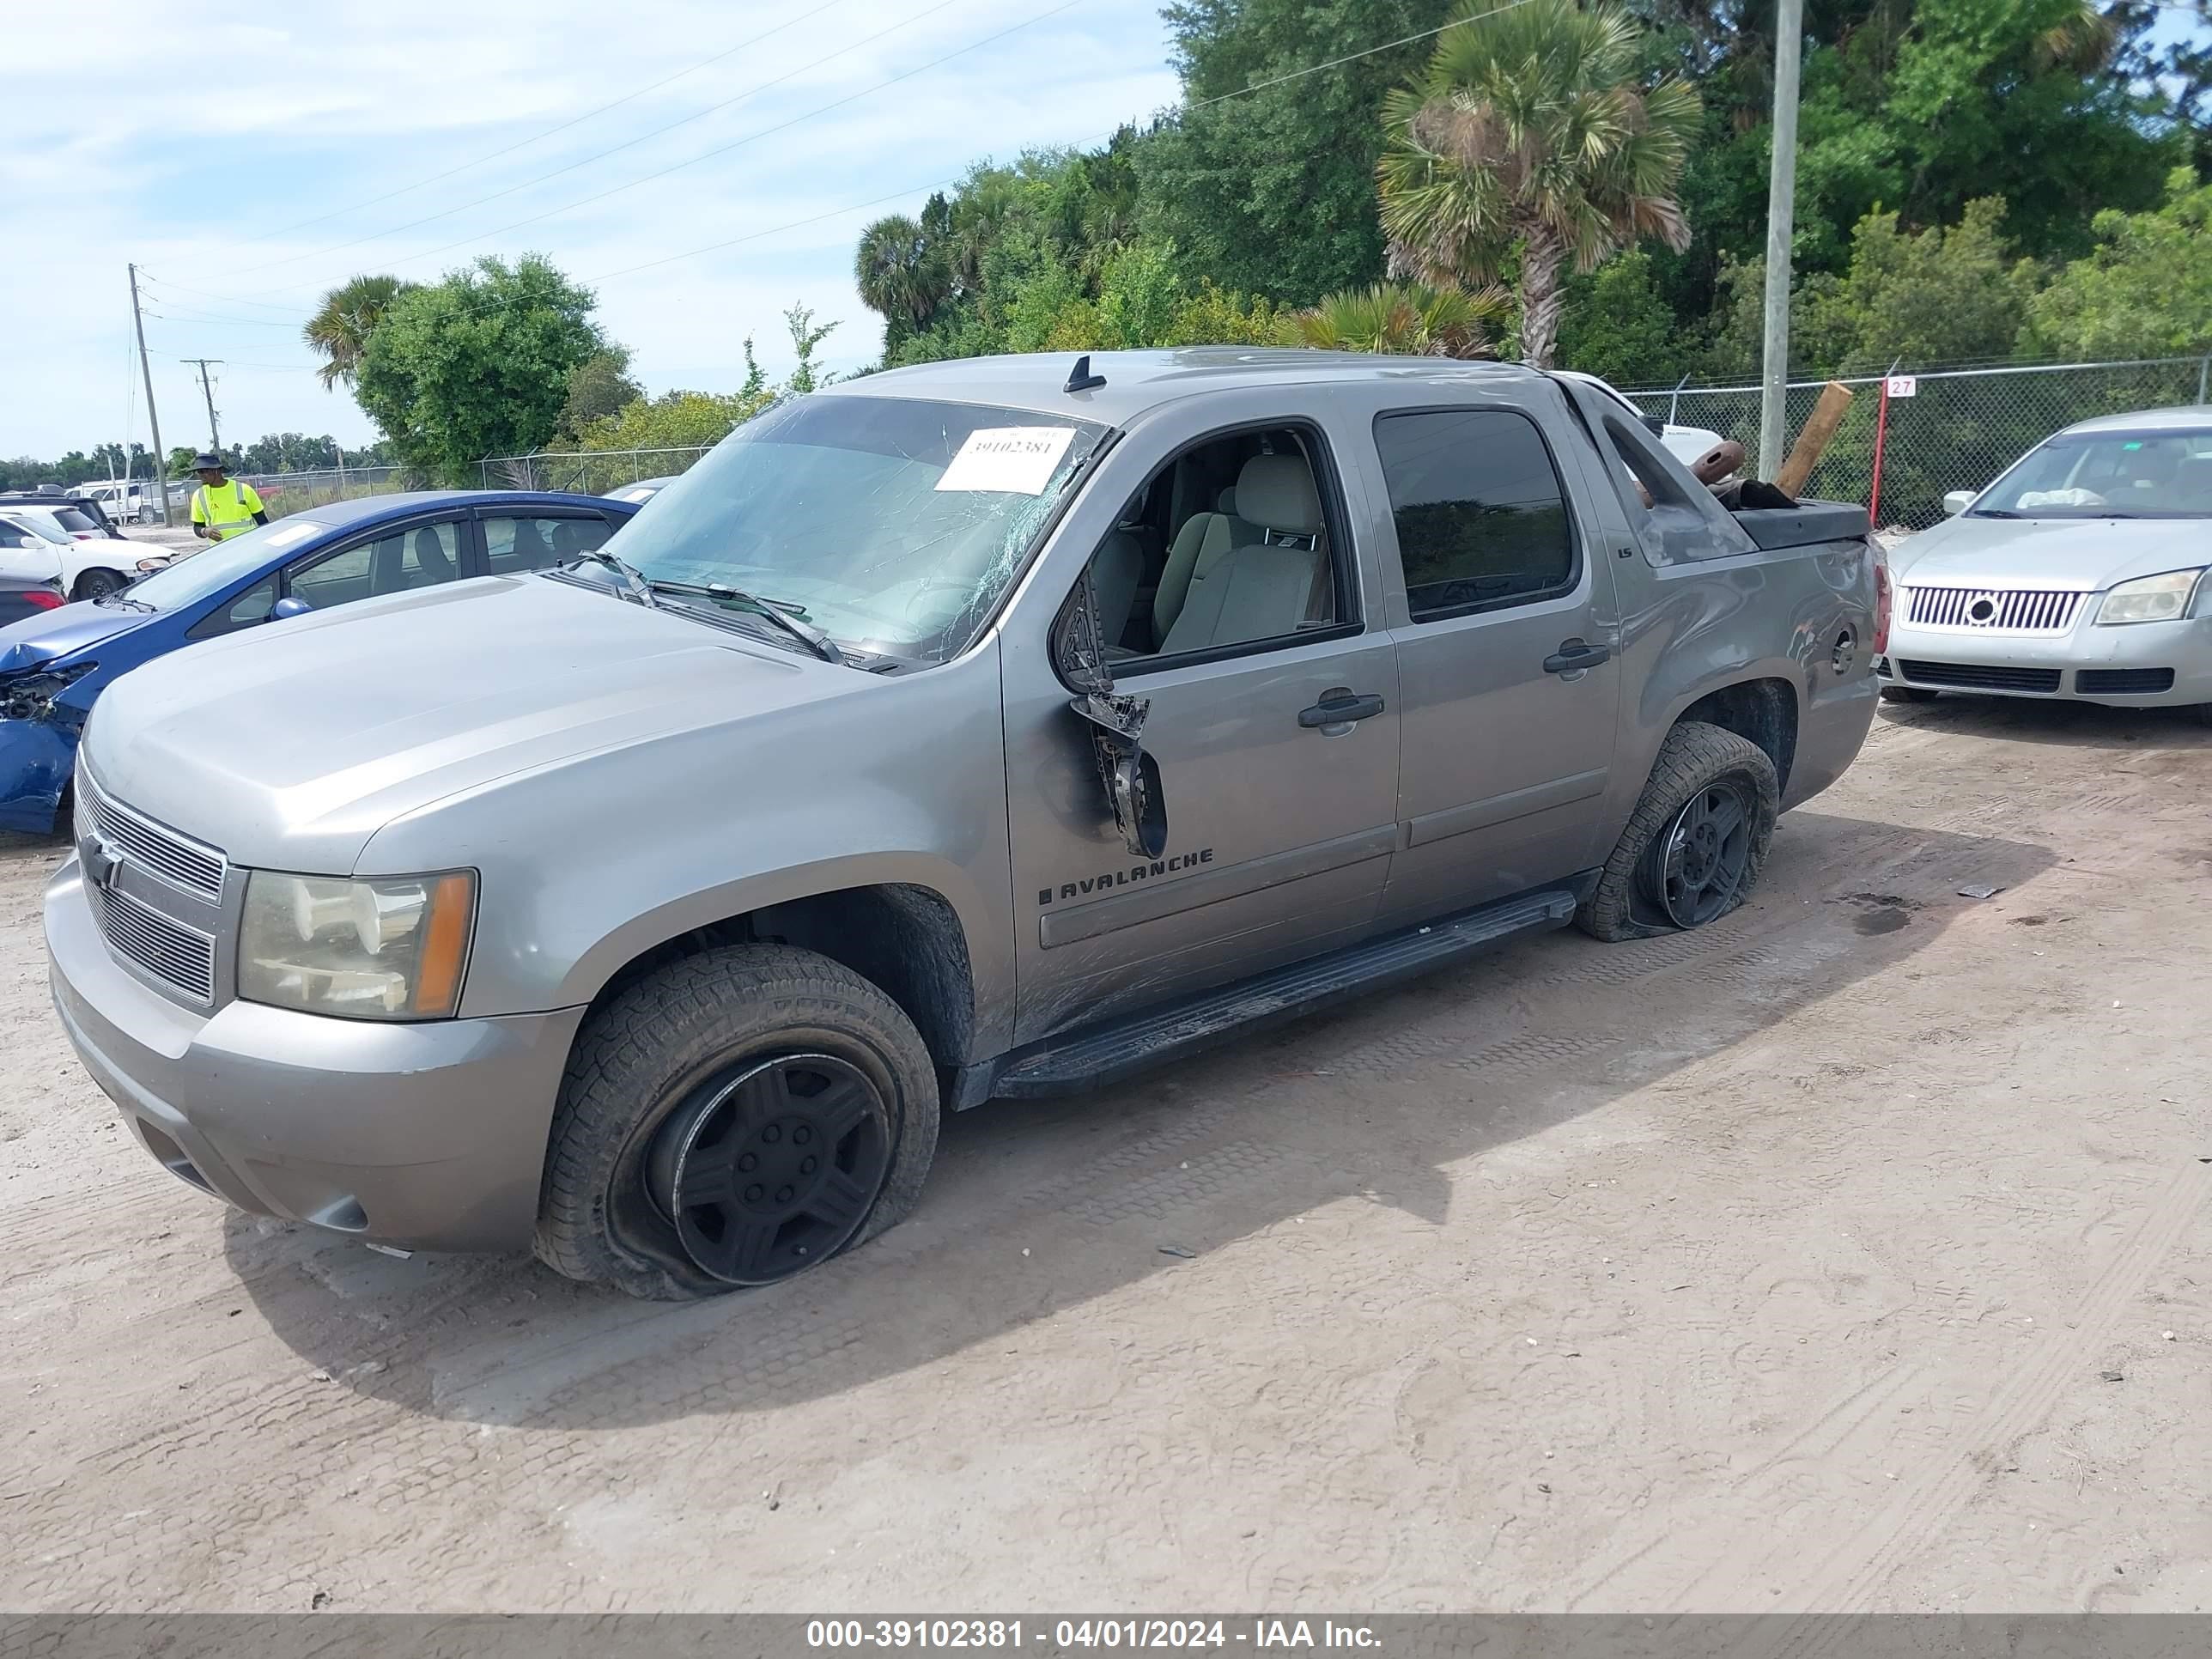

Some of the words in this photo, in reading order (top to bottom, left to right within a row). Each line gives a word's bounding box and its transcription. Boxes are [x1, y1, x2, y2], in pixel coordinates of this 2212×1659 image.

[1893, 380, 1911, 394] 27
[975, 441, 1052, 454] 39102381
[1618, 548, 1632, 559] LS
[1060, 848, 1213, 899] AVALANCHE
